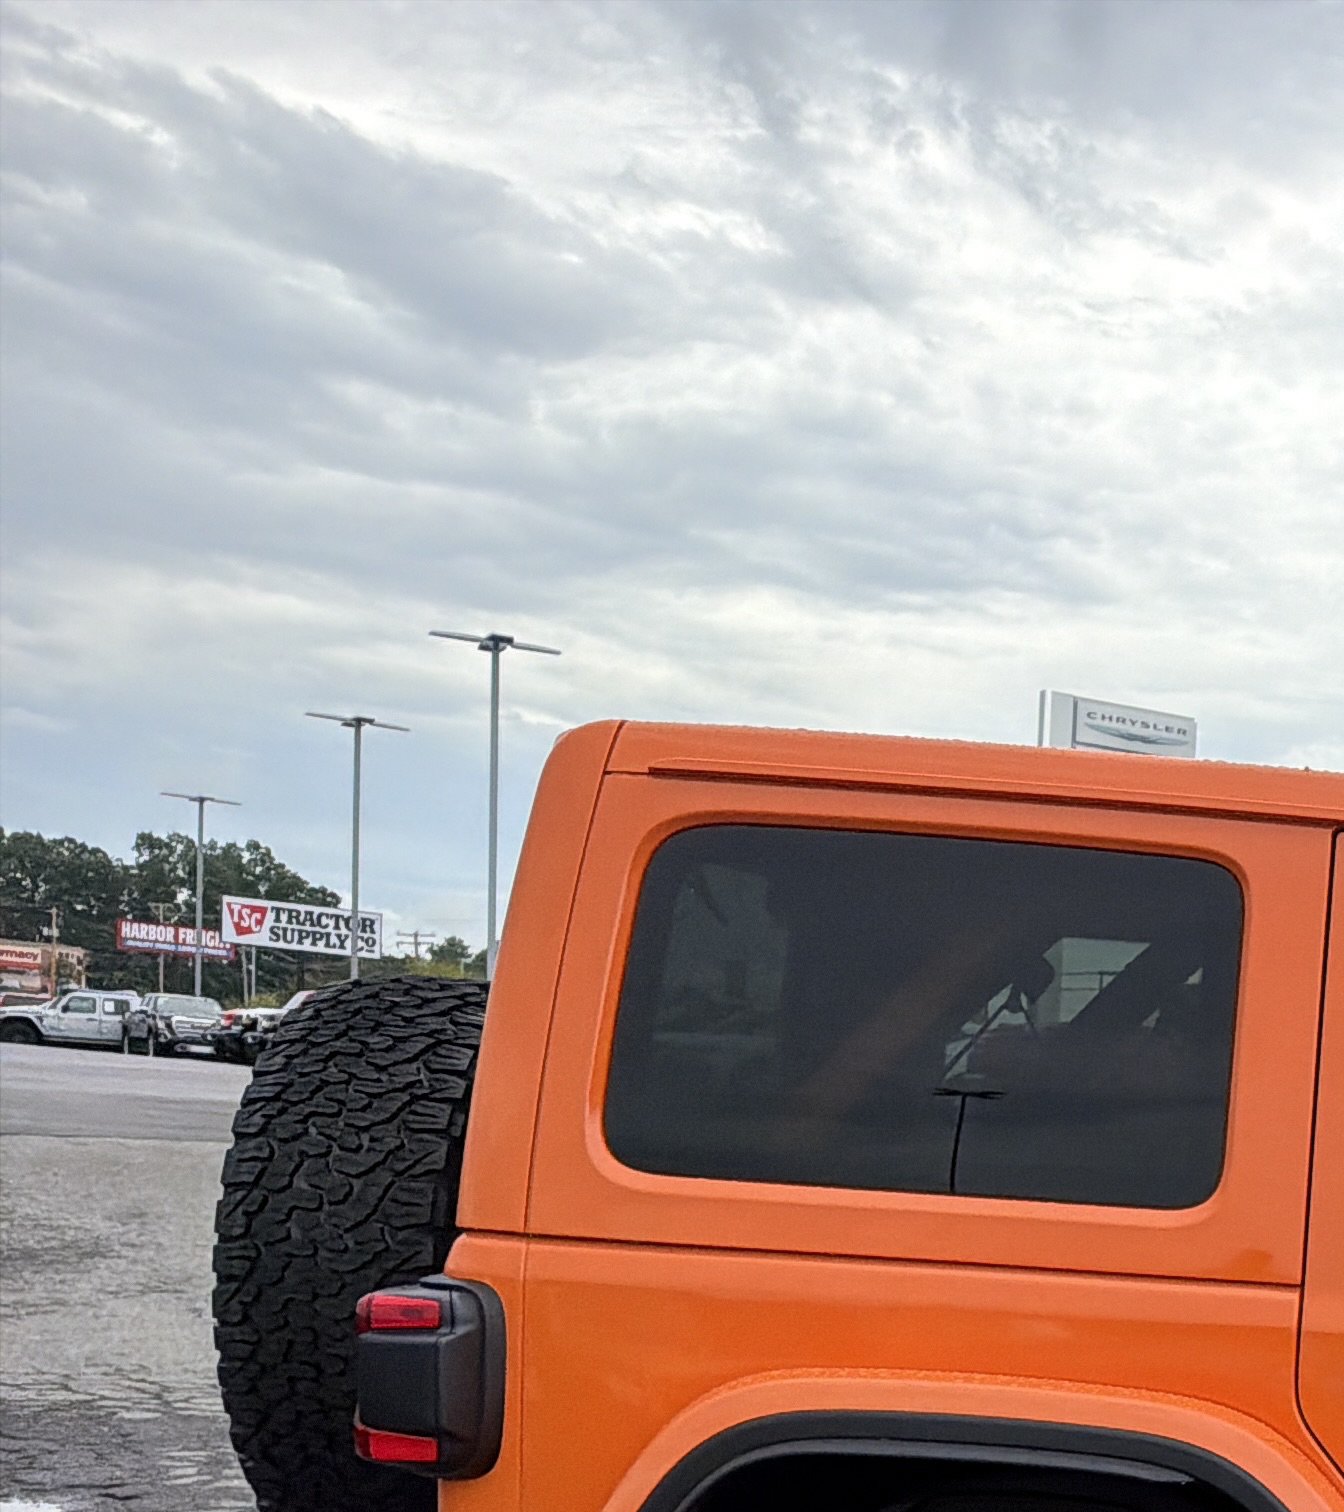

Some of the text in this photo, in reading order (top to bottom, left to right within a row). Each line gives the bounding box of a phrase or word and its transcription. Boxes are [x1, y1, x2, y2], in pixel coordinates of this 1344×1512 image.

[1086, 711, 1188, 737] CHRYSLER
[230, 903, 262, 932] TSC
[270, 906, 376, 935] TRACTOR
[121, 920, 175, 943] HARBOR
[178, 926, 231, 949] FRIG
[268, 925, 350, 951] SUPPLY
